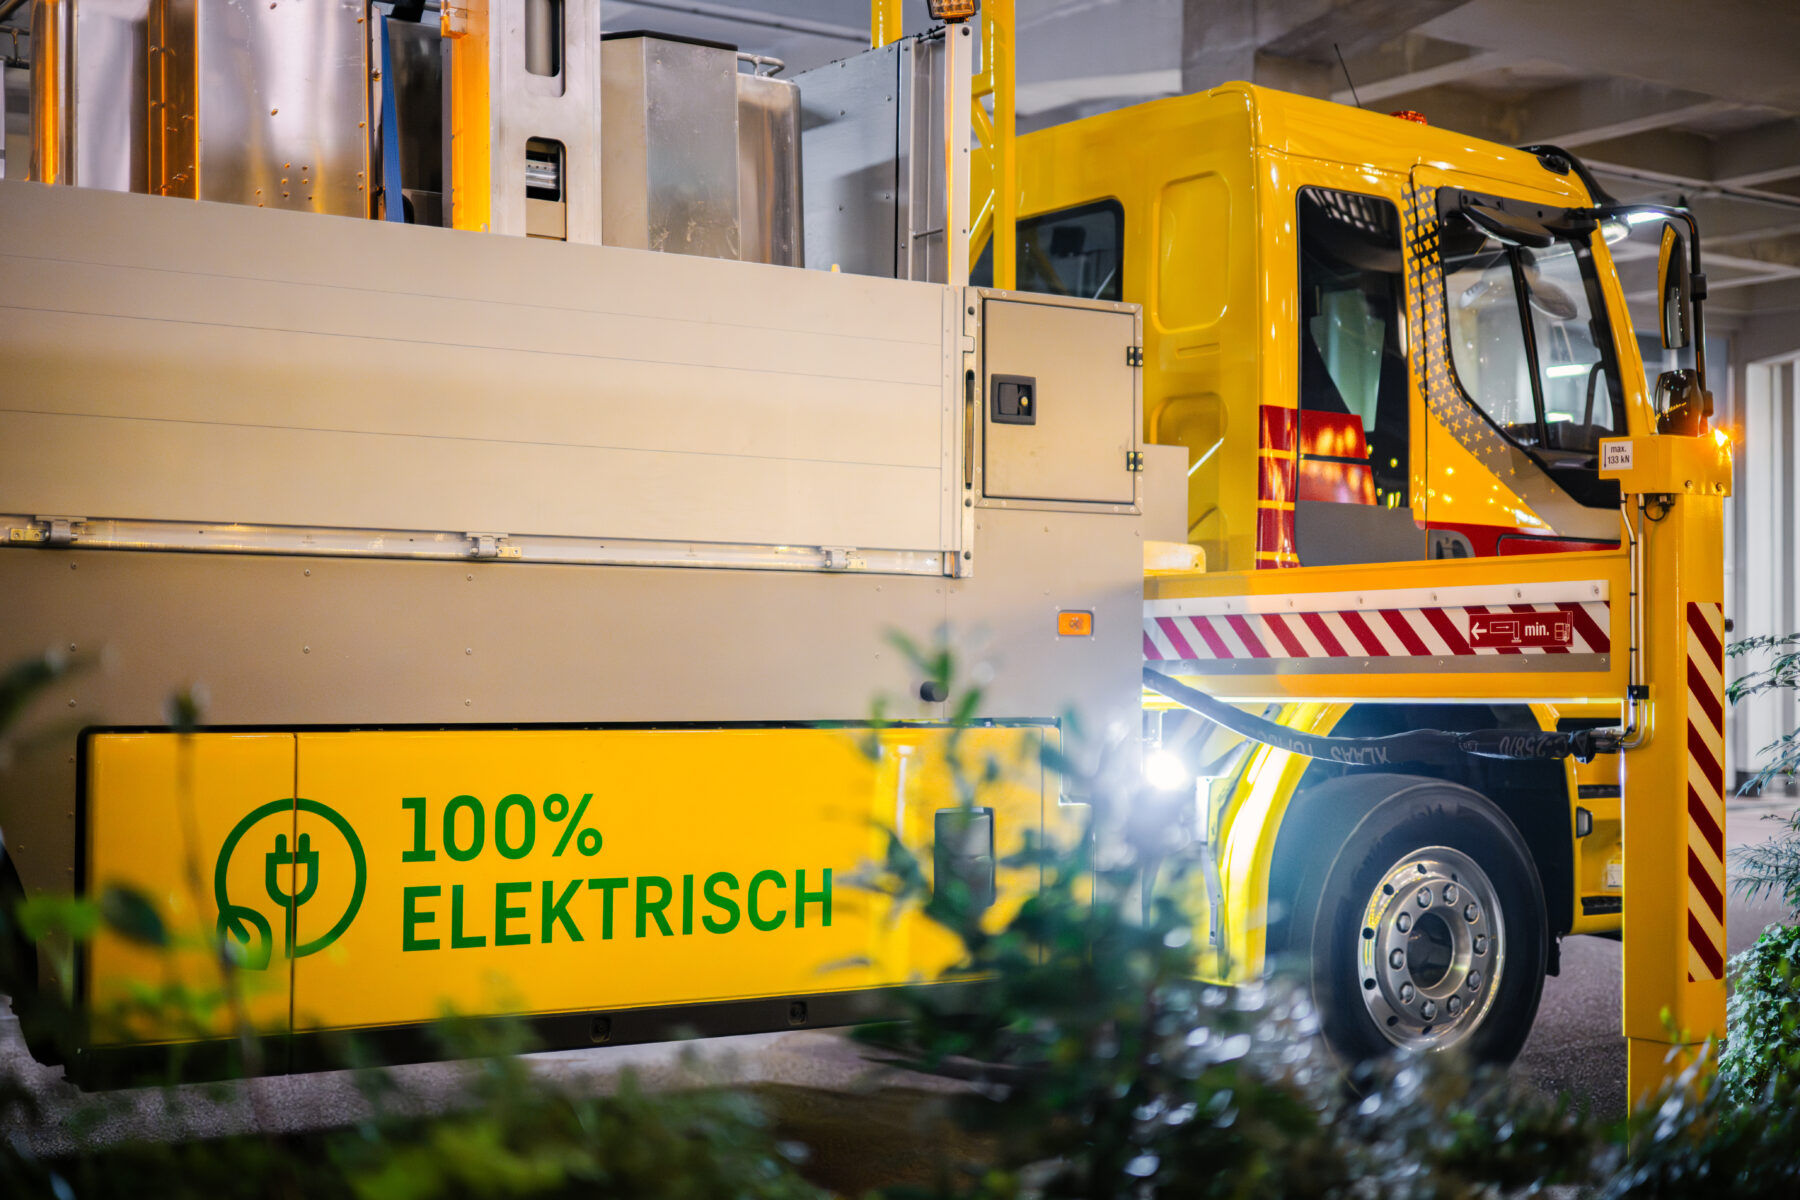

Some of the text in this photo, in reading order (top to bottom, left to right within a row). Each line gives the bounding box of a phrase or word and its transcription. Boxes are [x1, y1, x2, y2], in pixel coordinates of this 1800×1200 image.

[1608, 455, 1630, 464] 133 kN
[1525, 622, 1549, 636] min.
[402, 793, 603, 863] 100%
[403, 868, 833, 952] ELEKTRISCH
